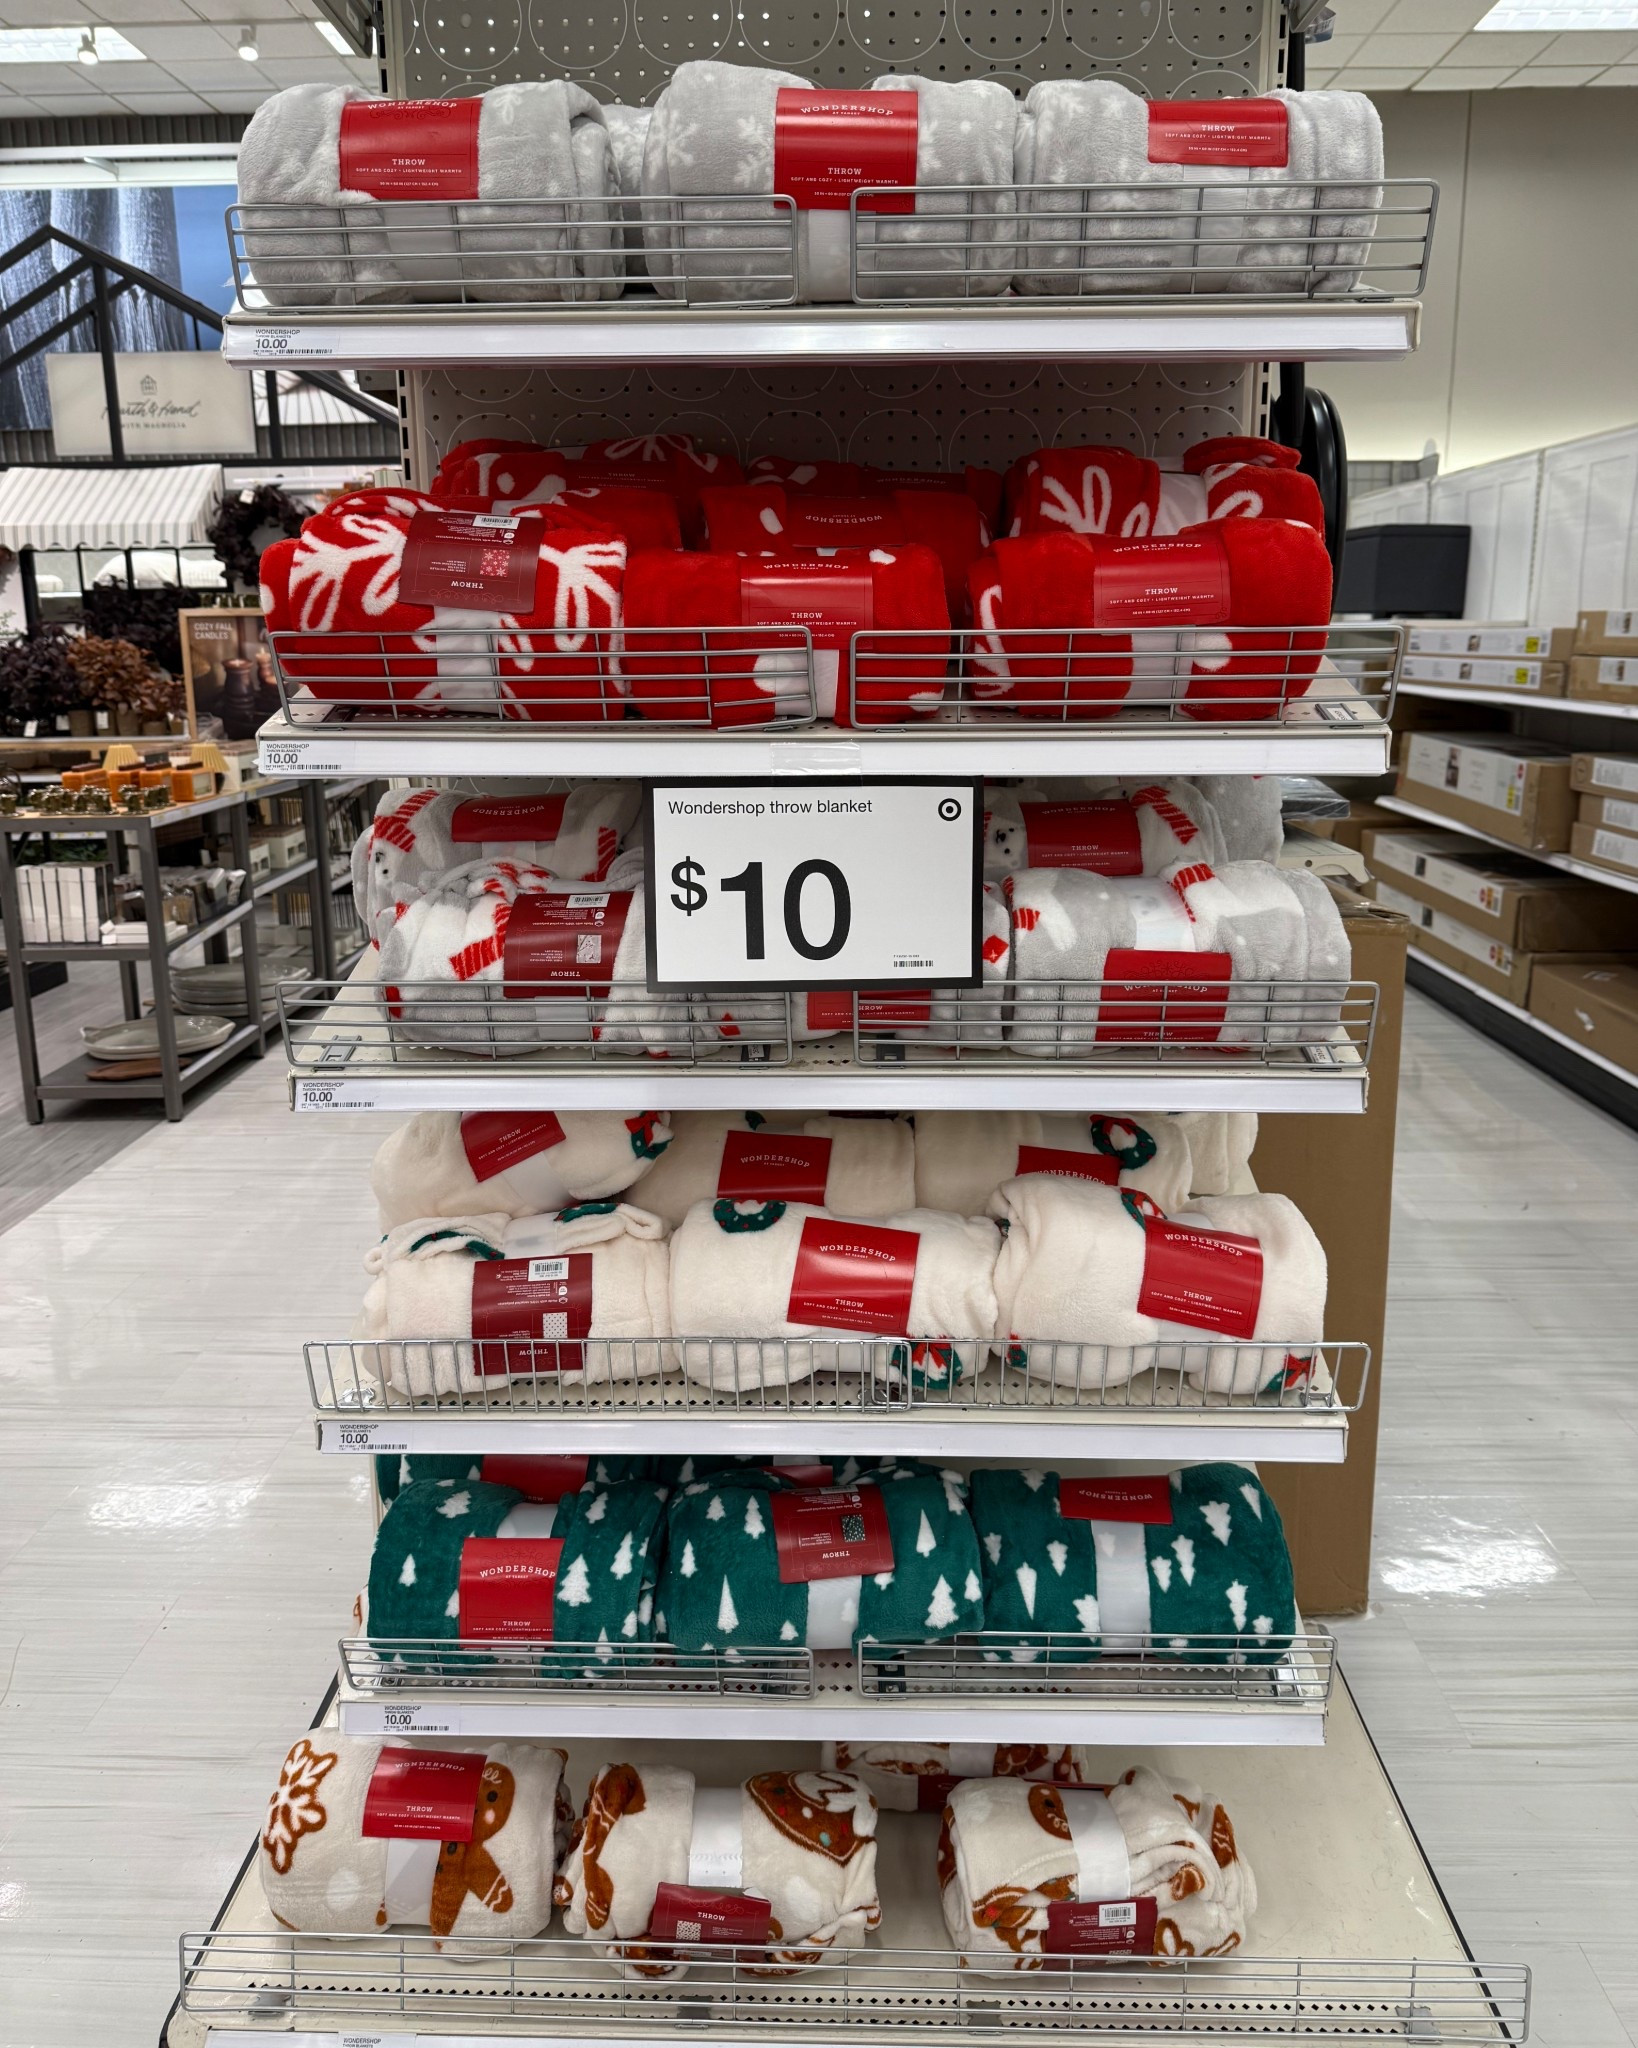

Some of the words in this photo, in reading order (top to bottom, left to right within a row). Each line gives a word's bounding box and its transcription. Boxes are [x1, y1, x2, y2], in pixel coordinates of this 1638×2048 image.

[367, 101, 458, 110] WONDERSHOP
[801, 104, 894, 116] WONDERSHOP
[1201, 124, 1235, 132] THROW
[392, 158, 426, 166] THROW
[828, 167, 862, 175] THROW
[255, 339, 288, 349] 10.00
[101, 399, 150, 418] arth
[805, 515, 883, 524] WONDERSHOP
[1113, 543, 1201, 553] WONDERSHOP
[451, 580, 484, 589] THROW
[1145, 587, 1178, 595] THROW
[194, 623, 213, 631] COZY
[215, 623, 233, 631] FALL
[195, 631, 229, 640] CANDLES
[267, 753, 298, 764] 10.00
[472, 805, 545, 816] WONDERSHOP
[668, 801, 765, 817] Wondershop
[770, 801, 813, 814] throw
[817, 799, 873, 813] blanket
[670, 856, 852, 961] $10
[303, 1092, 333, 1102] 10.00
[499, 1128, 521, 1143] THROW
[741, 1155, 810, 1167] WONDERSHOP
[1165, 1234, 1243, 1256] WONDERSHOP
[820, 1244, 896, 1262] WONDERSHOP
[1184, 1291, 1213, 1302] THROW
[835, 1299, 864, 1308] THROW
[1191, 1300, 1222, 1310] LIGHTWEIGHT
[519, 1348, 548, 1356] THOW
[340, 1433, 368, 1444] 10.00
[1079, 1490, 1152, 1501] WONDERSHOP
[822, 1550, 850, 1559] THROW
[480, 1565, 556, 1578] WONDERSHOP
[385, 1715, 412, 1725] 10.00
[395, 1761, 465, 1772] WONDERSHOP
[406, 1805, 433, 1813] THROW
[698, 1912, 725, 1921] THROW
